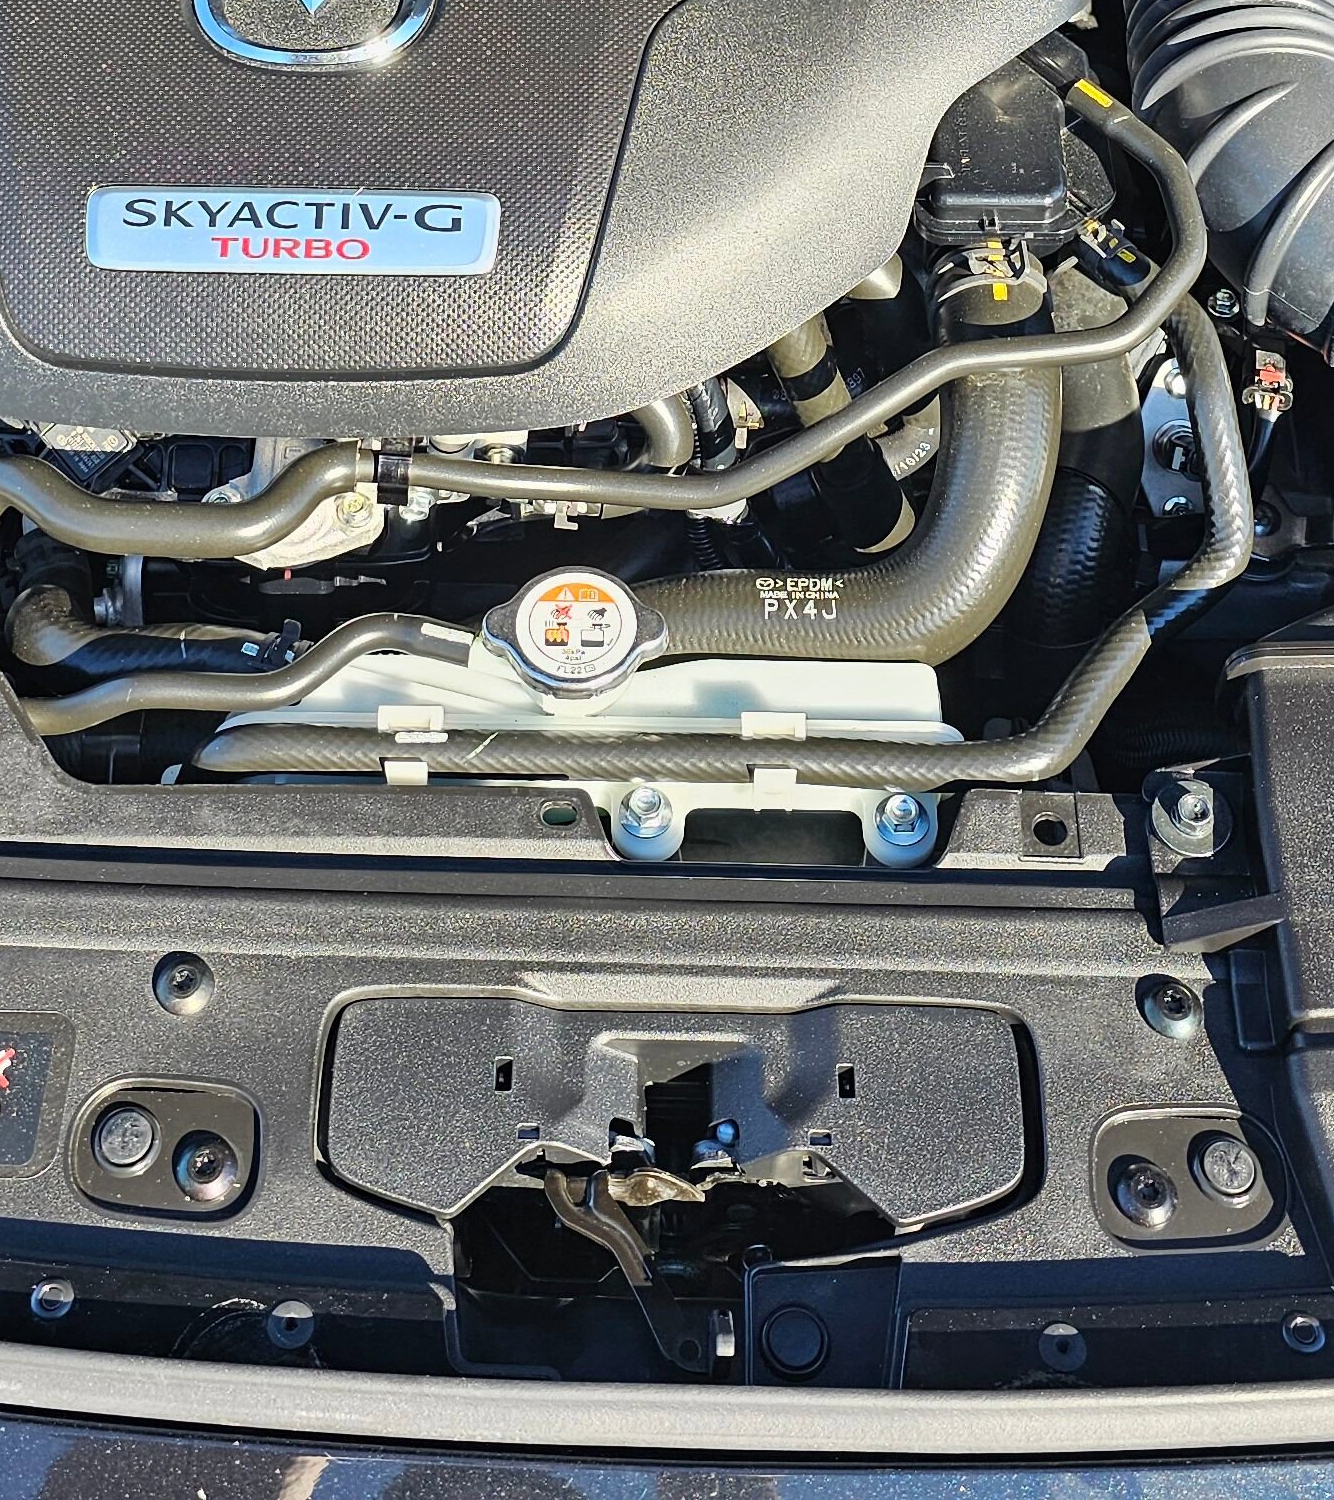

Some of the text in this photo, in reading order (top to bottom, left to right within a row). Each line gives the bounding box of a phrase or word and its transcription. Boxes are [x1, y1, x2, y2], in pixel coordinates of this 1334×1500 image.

[122, 198, 463, 233] SKYACTIV-G
[211, 237, 371, 260] TURBO
[760, 590, 840, 600] MADE IN CHINA
[764, 599, 837, 620] PX4J
